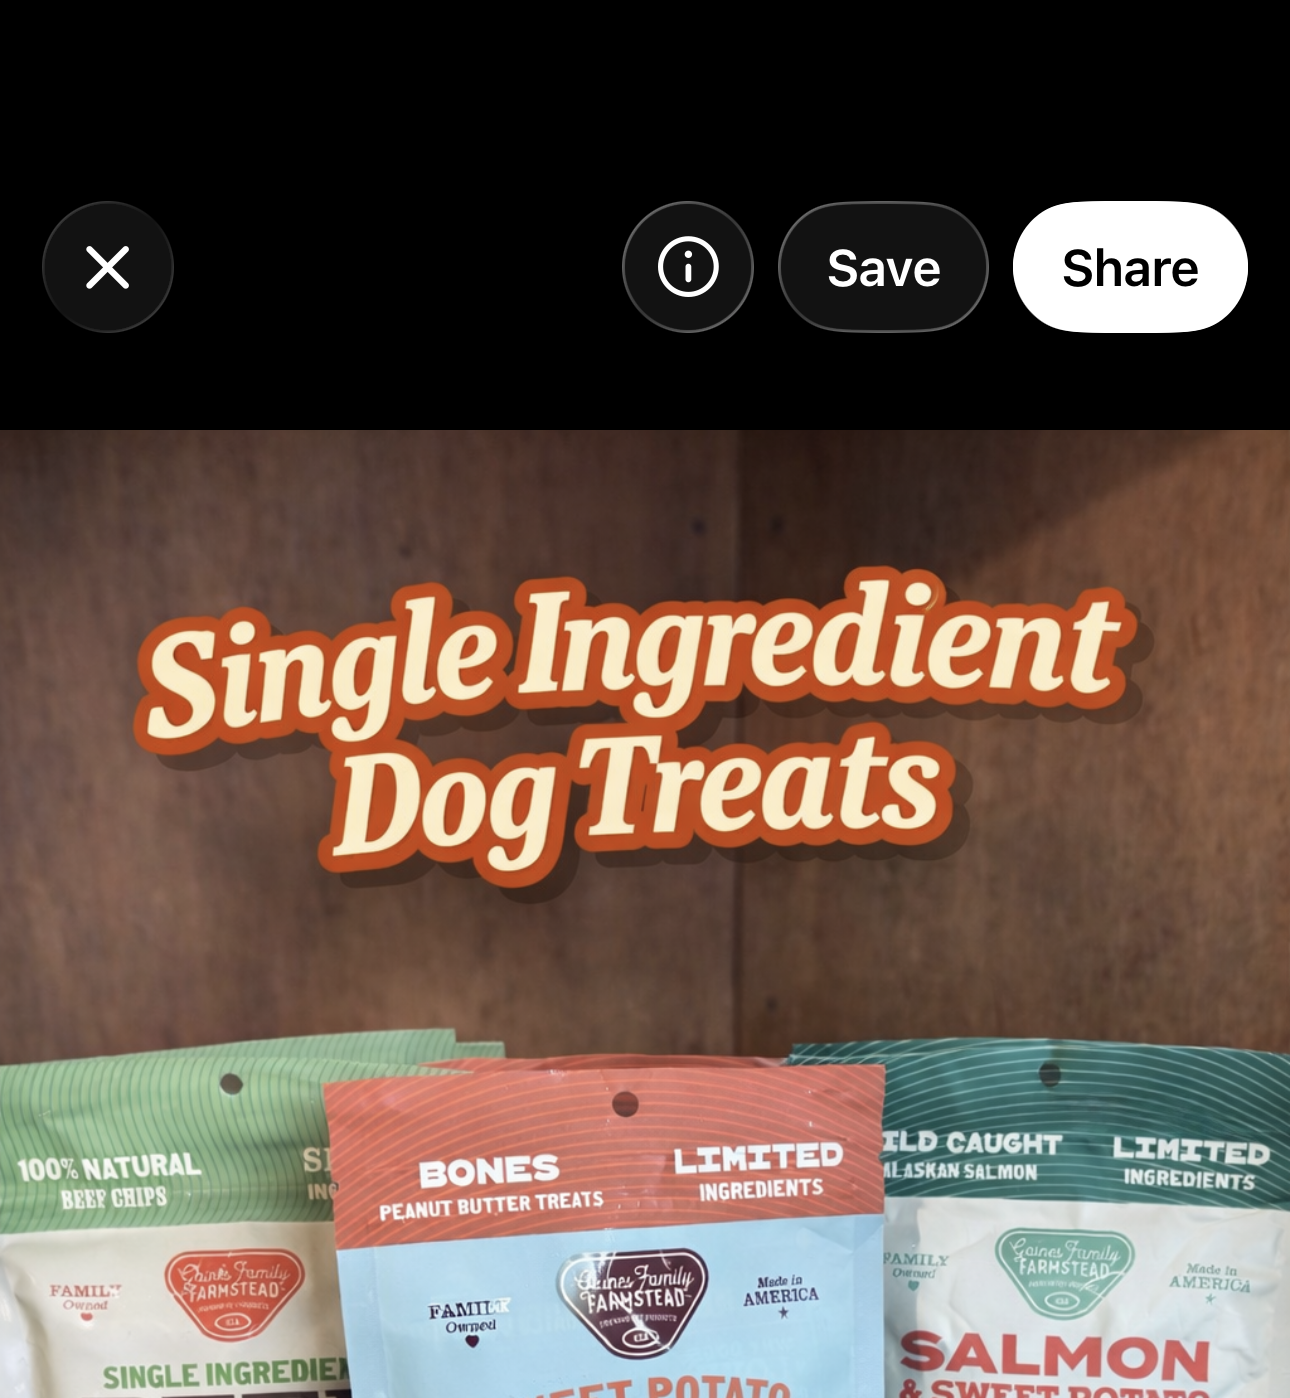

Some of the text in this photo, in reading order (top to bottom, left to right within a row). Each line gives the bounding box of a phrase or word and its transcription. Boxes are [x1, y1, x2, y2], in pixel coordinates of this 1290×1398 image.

[827, 248, 942, 288] Save
[1062, 247, 1200, 288] Share
[883, 1131, 1063, 1155] ILD CAUGHT
[1113, 1136, 1270, 1166] LIMITED
[18, 1152, 201, 1183] 100% NATURAL
[675, 1142, 844, 1174] LIMITED
[884, 1161, 1037, 1180] ALASKAN SALMON
[419, 1154, 560, 1189] BONES
[1124, 1168, 1255, 1191] INGREDIENTS
[61, 1186, 167, 1209] BEEF CHIPS
[700, 1179, 823, 1202] INGREDIENTS
[379, 1191, 604, 1221] PEANUT BUTTER TREATS
[757, 1275, 803, 1289] Made in
[1186, 1263, 1222, 1276] Made
[743, 1287, 819, 1307] AMERICA
[1169, 1276, 1251, 1293] AMERICA
[901, 1330, 1210, 1383] SALMON
[103, 1363, 200, 1390] SINGLE
